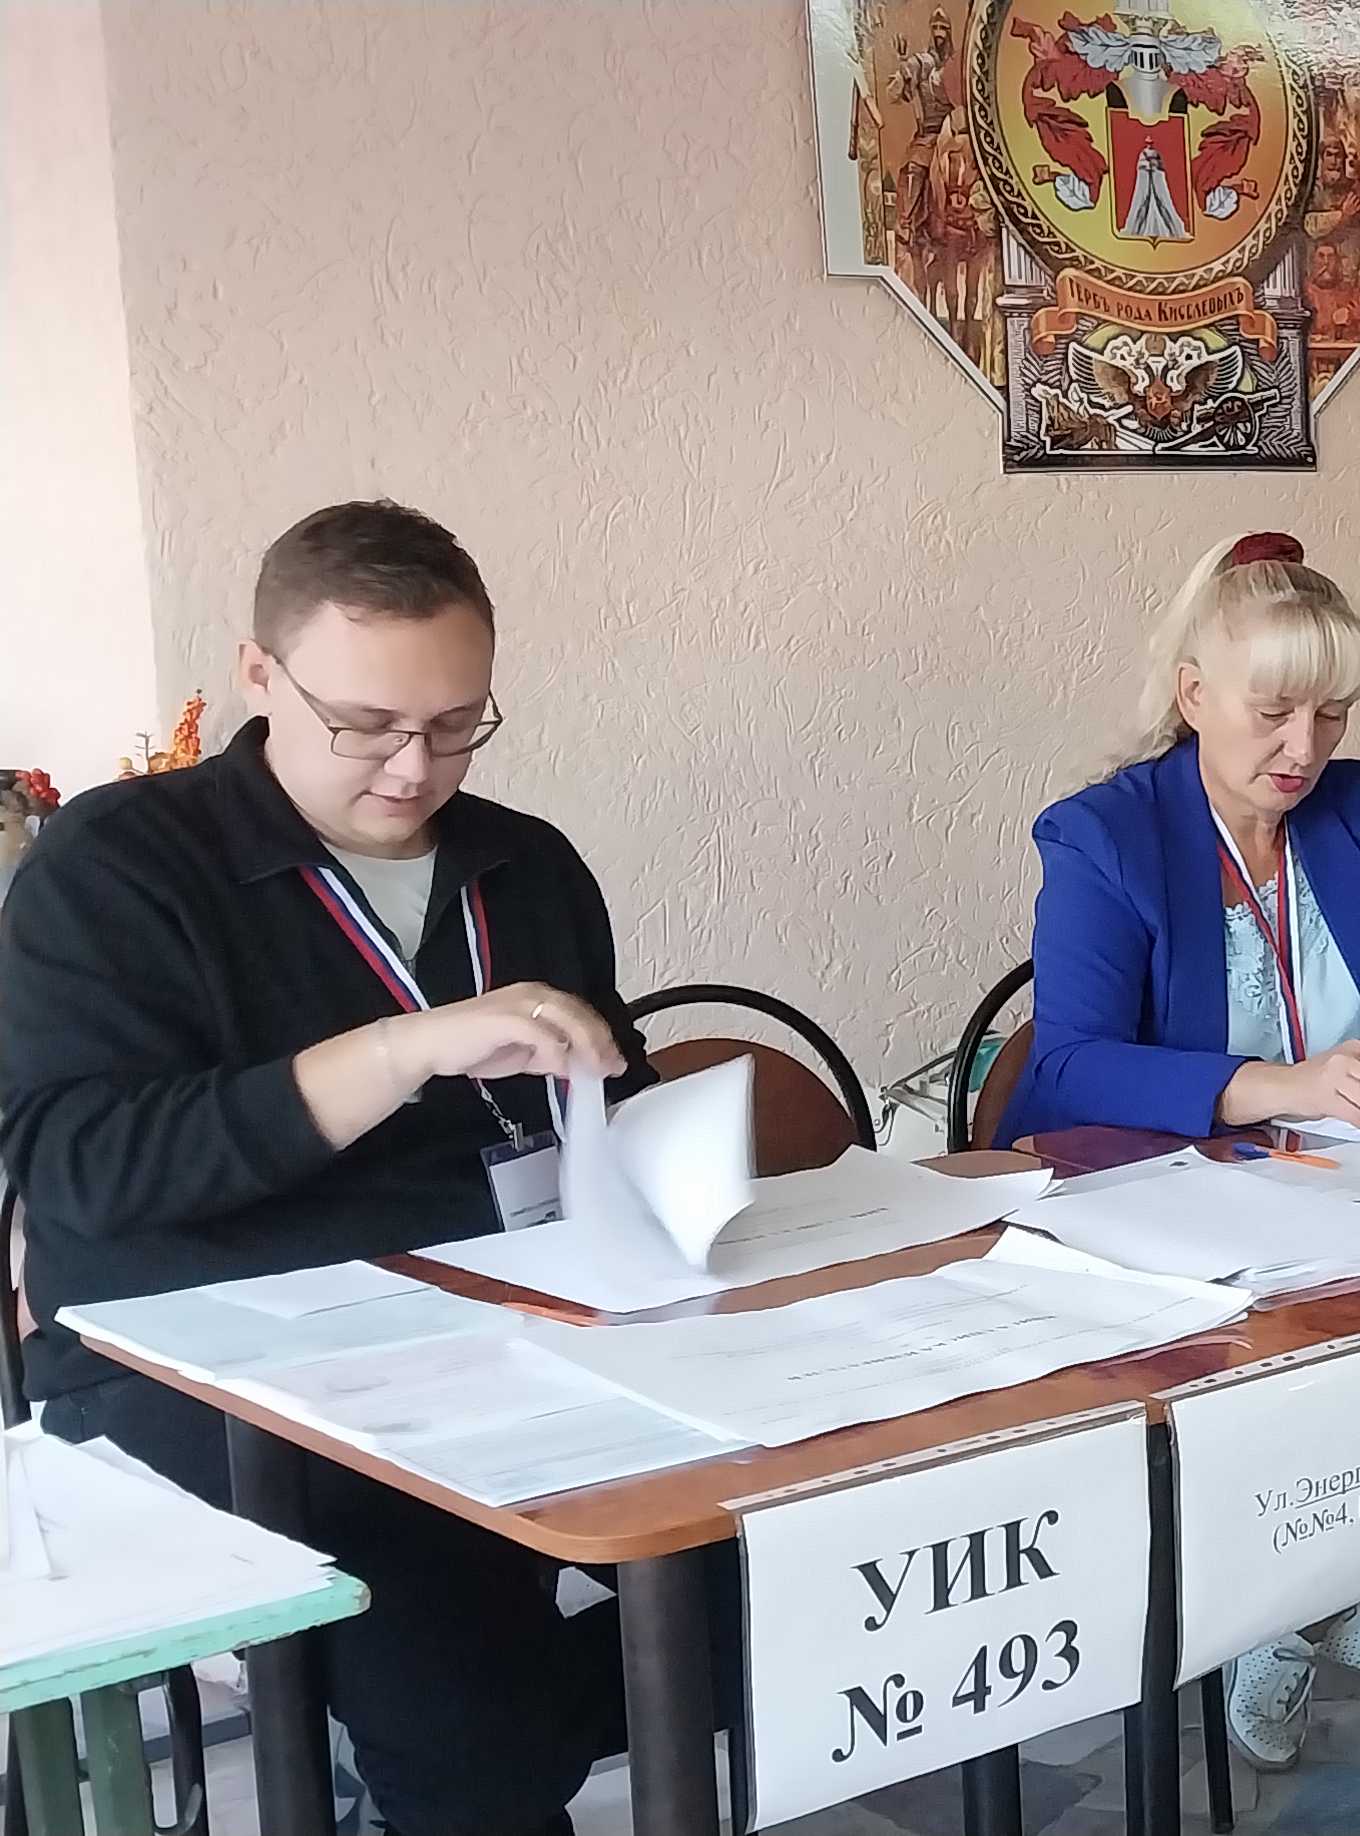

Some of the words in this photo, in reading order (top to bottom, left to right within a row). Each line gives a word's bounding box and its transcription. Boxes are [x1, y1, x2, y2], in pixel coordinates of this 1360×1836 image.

[850, 1510, 1061, 1632] УИК
[831, 1673, 925, 1763] №
[951, 1619, 1081, 1715] 493
